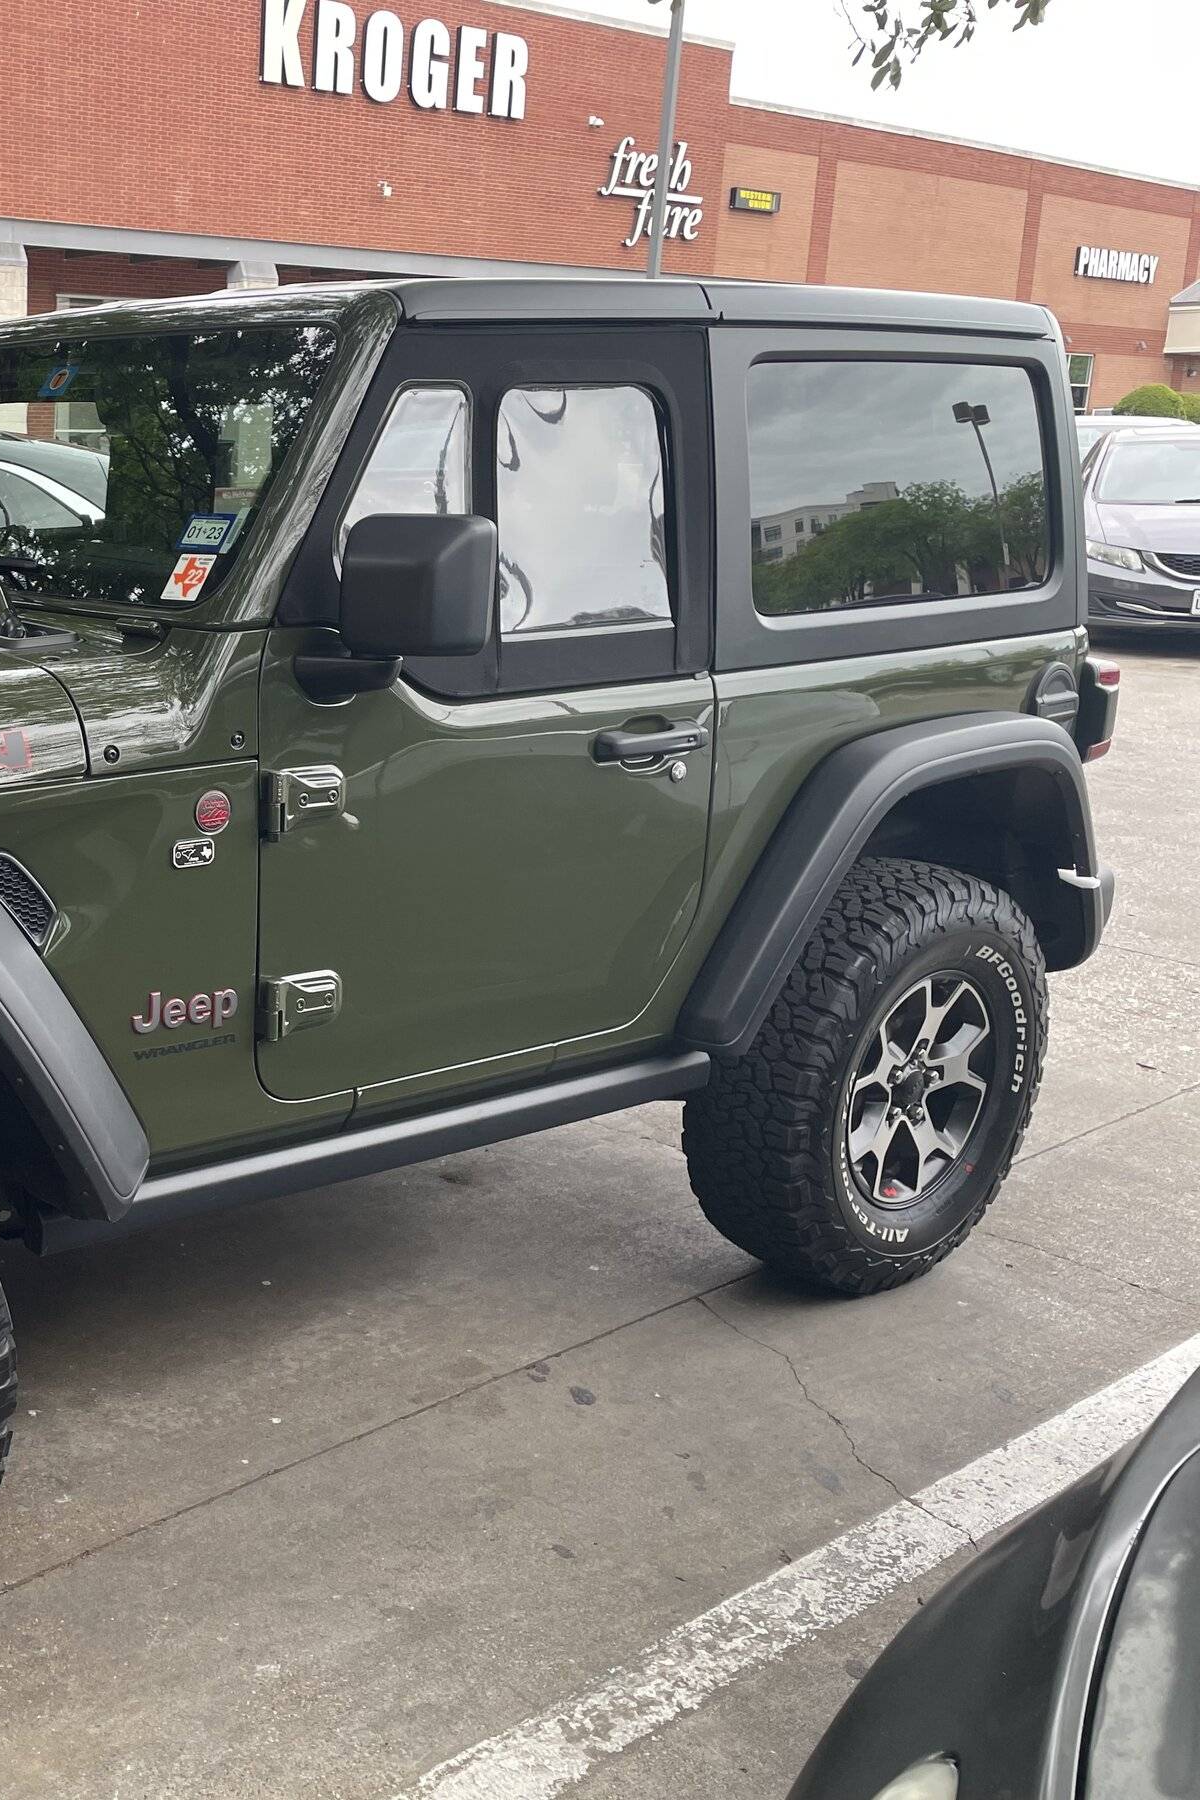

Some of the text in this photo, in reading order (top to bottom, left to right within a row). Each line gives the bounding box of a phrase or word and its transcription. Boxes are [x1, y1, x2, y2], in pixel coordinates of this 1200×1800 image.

[260, 0, 529, 120] KROGER
[600, 136, 692, 196] freh
[1077, 245, 1159, 285] PHARMACY
[183, 568, 204, 585] 22
[131, 987, 239, 1035] Jeep
[975, 944, 1027, 1094] BFGoodrich
[132, 1033, 237, 1061] WRANGLER
